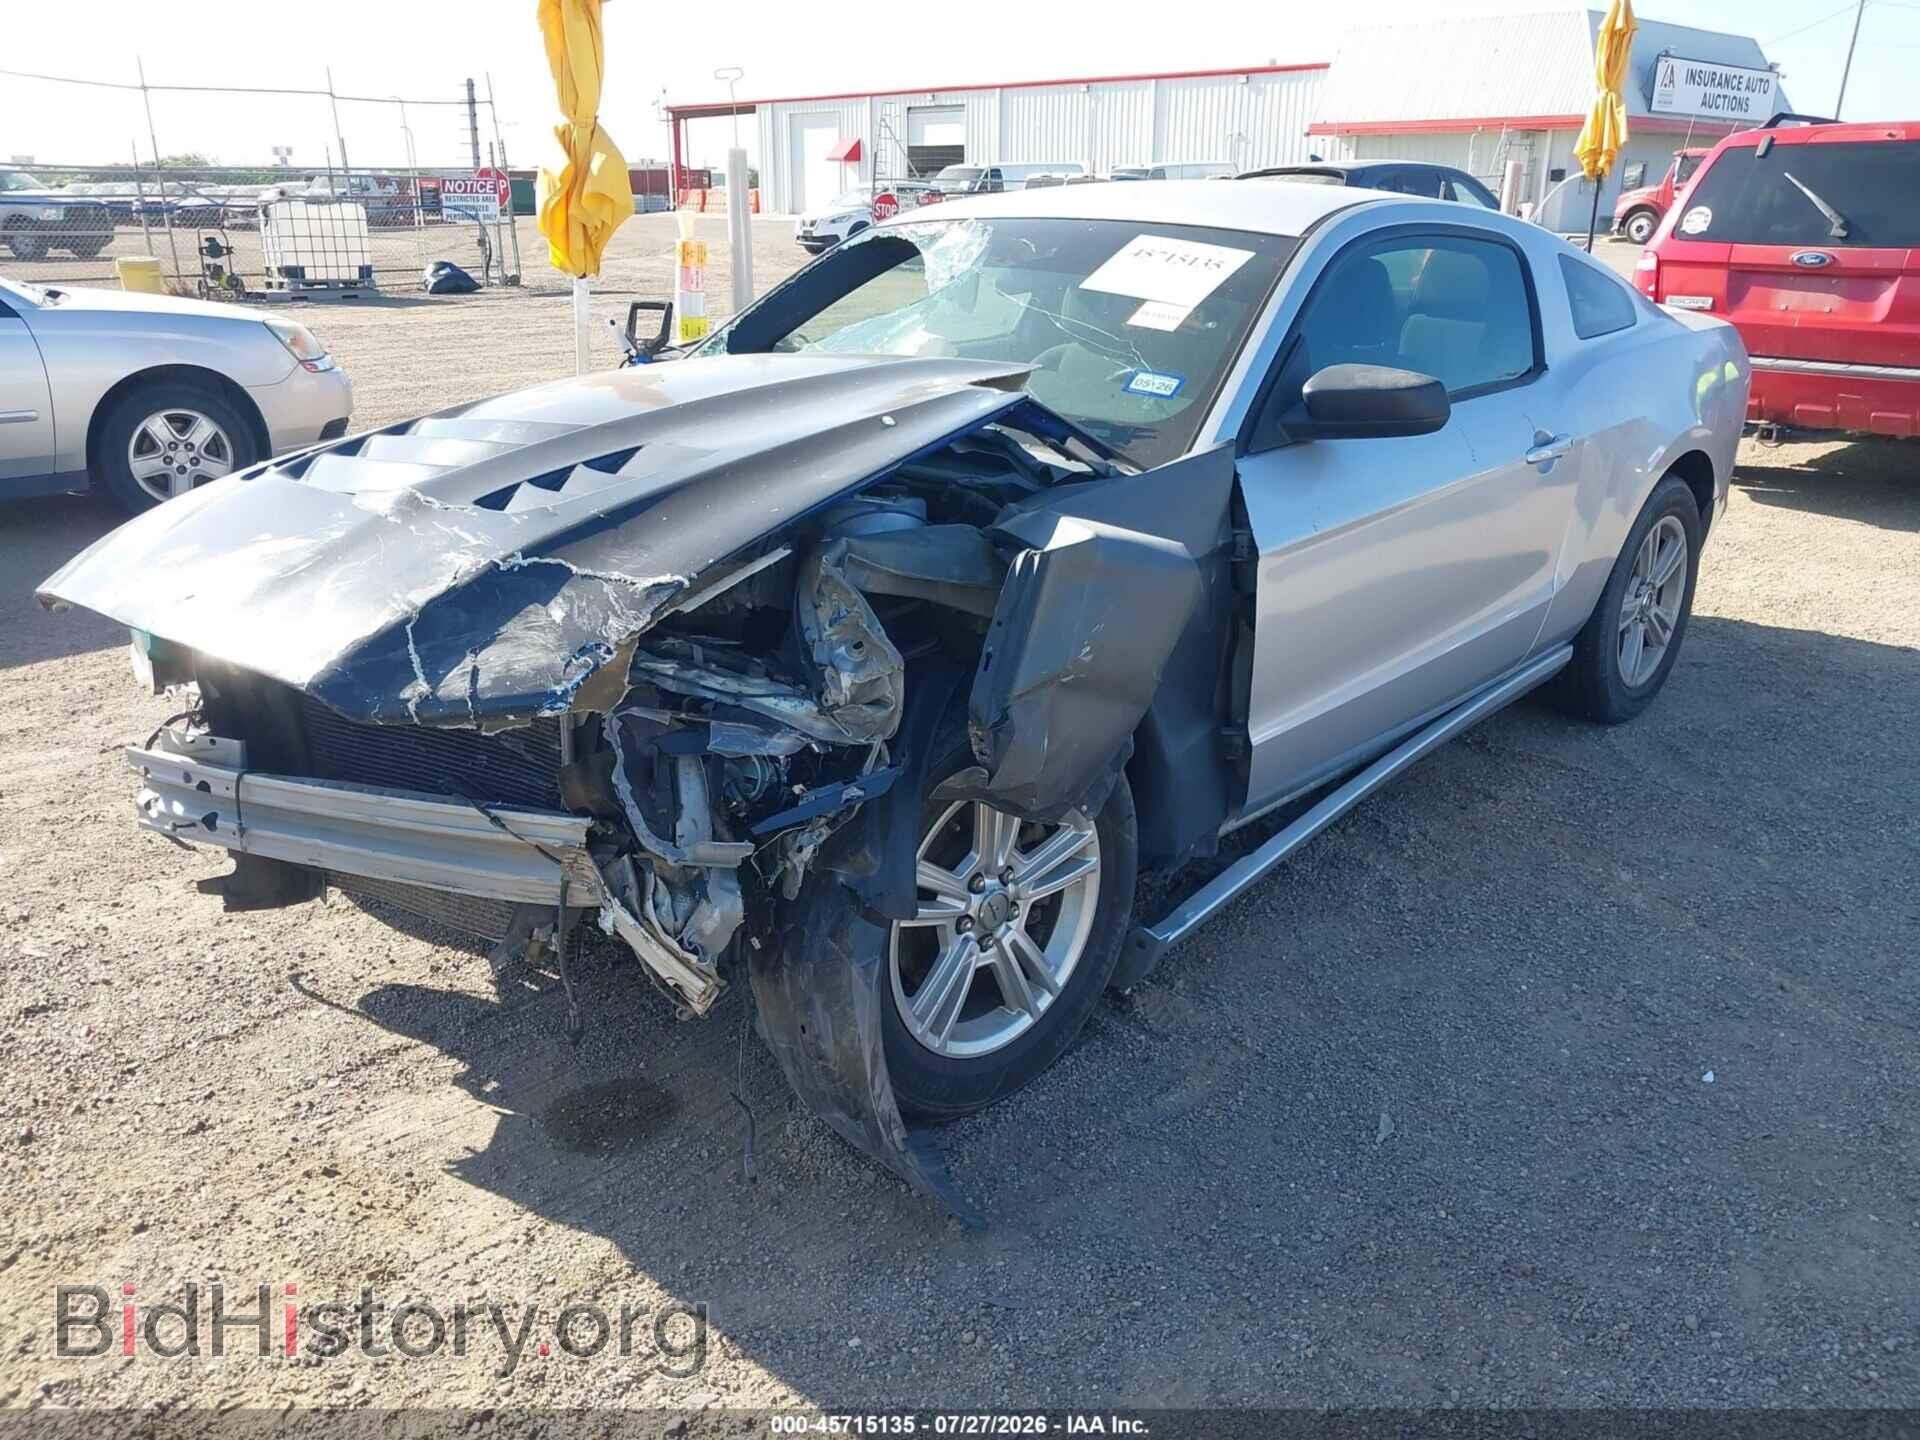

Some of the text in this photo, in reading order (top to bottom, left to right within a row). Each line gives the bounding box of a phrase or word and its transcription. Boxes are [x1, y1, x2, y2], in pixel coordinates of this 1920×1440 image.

[1685, 68, 1742, 90] INSURANCE
[1745, 76, 1770, 94] AUTO
[1701, 92, 1750, 112] AUCTIONS
[445, 180, 495, 193] NOTICE
[875, 203, 897, 216] STOP
